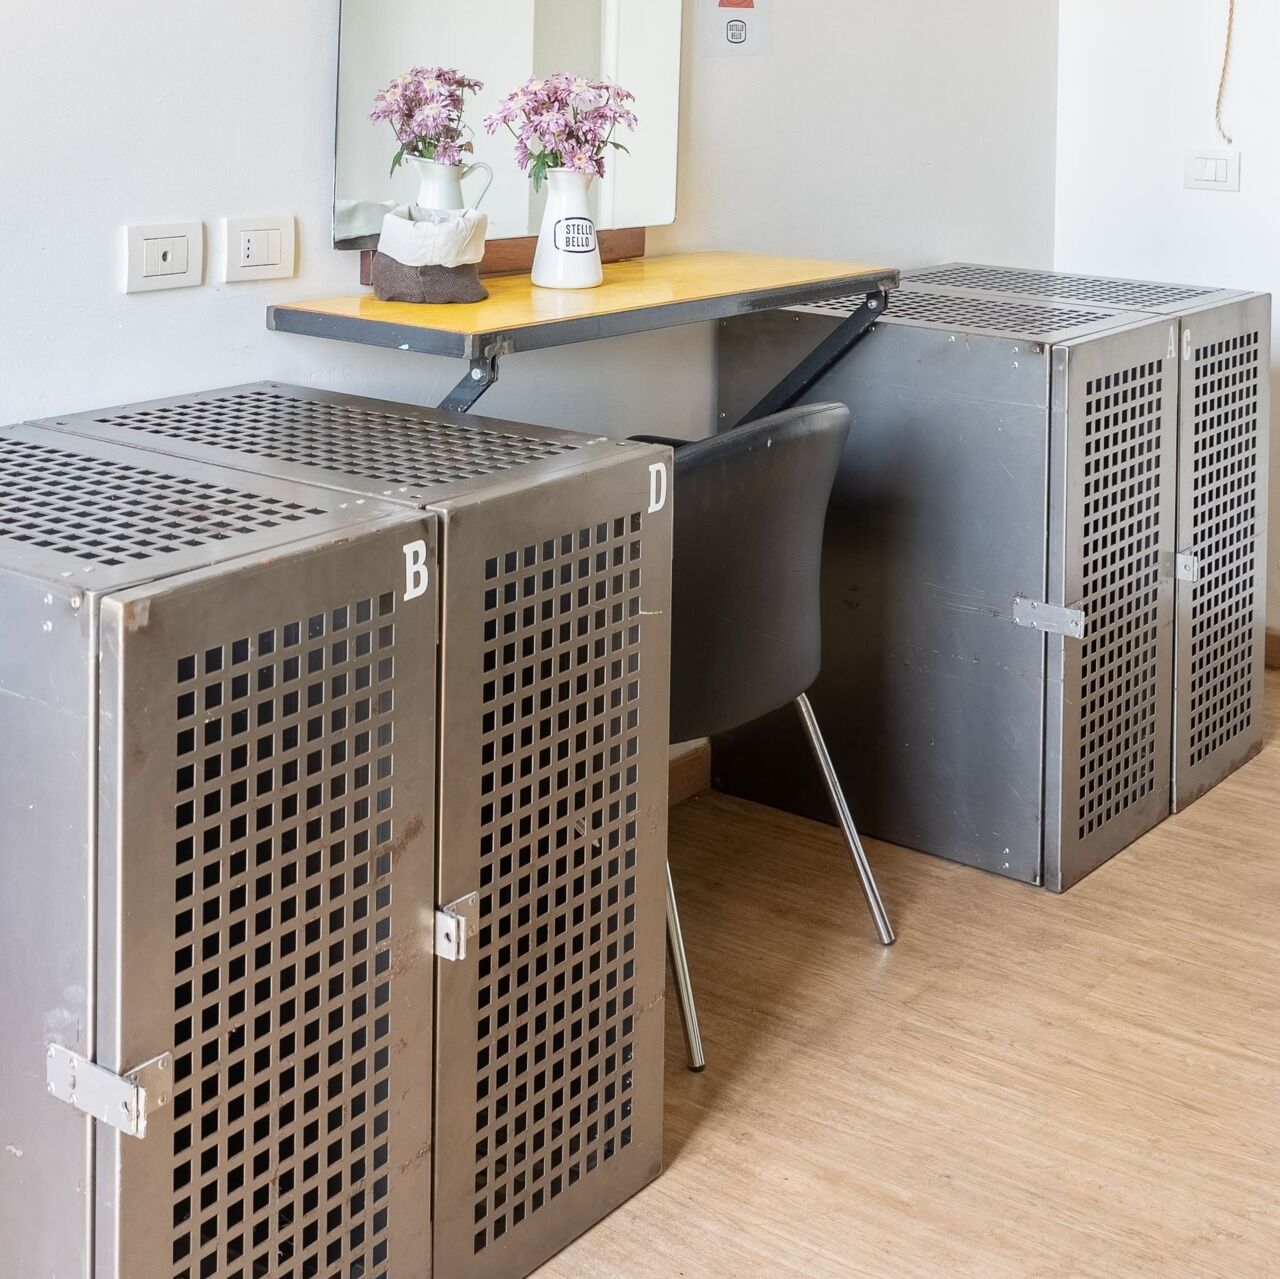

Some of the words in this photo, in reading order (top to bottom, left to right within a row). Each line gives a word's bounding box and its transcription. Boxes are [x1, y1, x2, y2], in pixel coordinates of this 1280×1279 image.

[565, 236, 590, 247] BELLO
[648, 462, 667, 514] D
[402, 539, 429, 602] B
